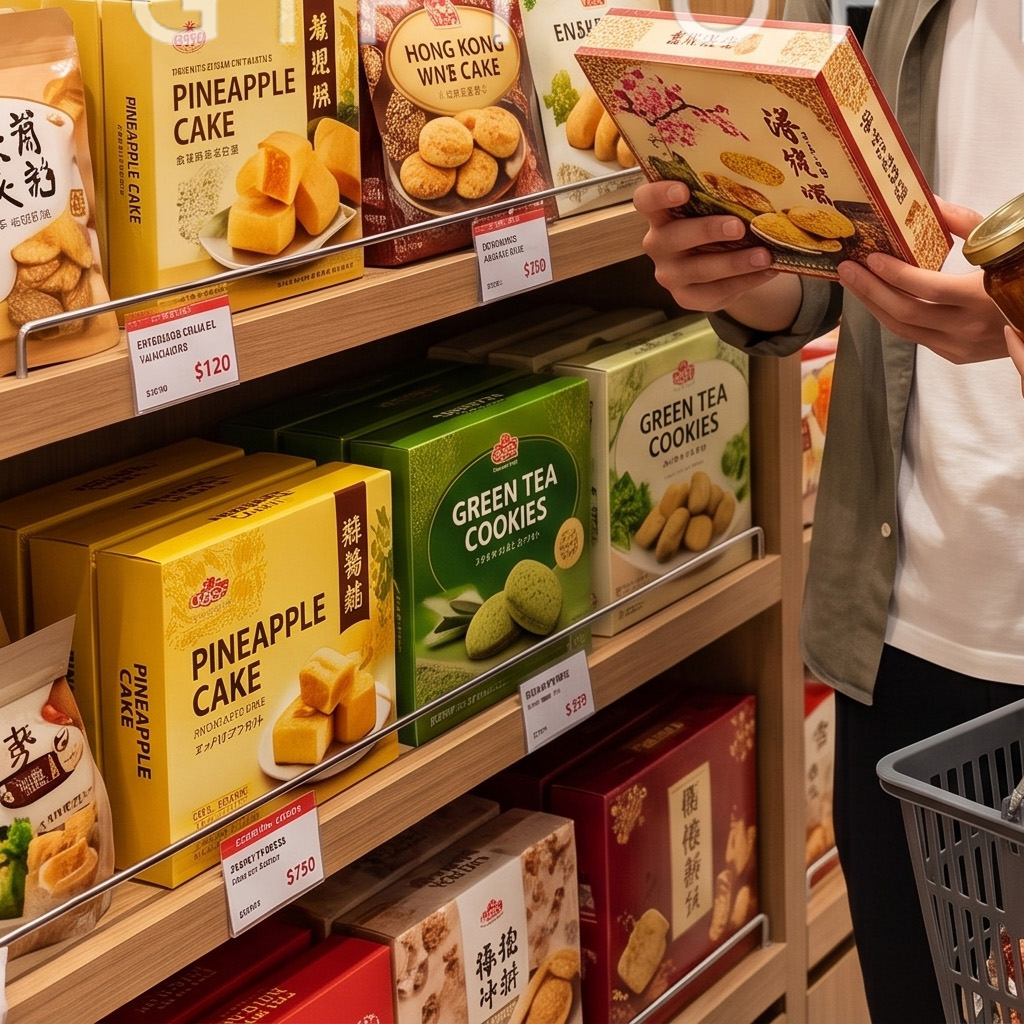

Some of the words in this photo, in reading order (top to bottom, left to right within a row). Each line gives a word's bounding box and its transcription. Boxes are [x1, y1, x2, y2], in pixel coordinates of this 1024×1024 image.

[404, 39, 455, 63] HONG
[457, 34, 504, 57] KONG
[460, 58, 500, 80] CAKE
[173, 67, 296, 112] PINEAPPLE
[126, 96, 140, 179] PINEAPPLE
[173, 110, 235, 146] CAKE
[128, 183, 141, 224] CAKE
[194, 354, 231, 382] $120
[640, 396, 693, 434] GREEN
[697, 383, 728, 412] TEA
[649, 411, 719, 458] COOKIES
[452, 479, 518, 526] GREEN
[522, 463, 558, 497] TEA
[465, 496, 548, 552] COOKIES
[191, 592, 326, 681] PINEAPPLE
[120, 669, 134, 729] CAKE
[193, 660, 261, 717] CAKE
[134, 663, 151, 779] PINEAPPLE
